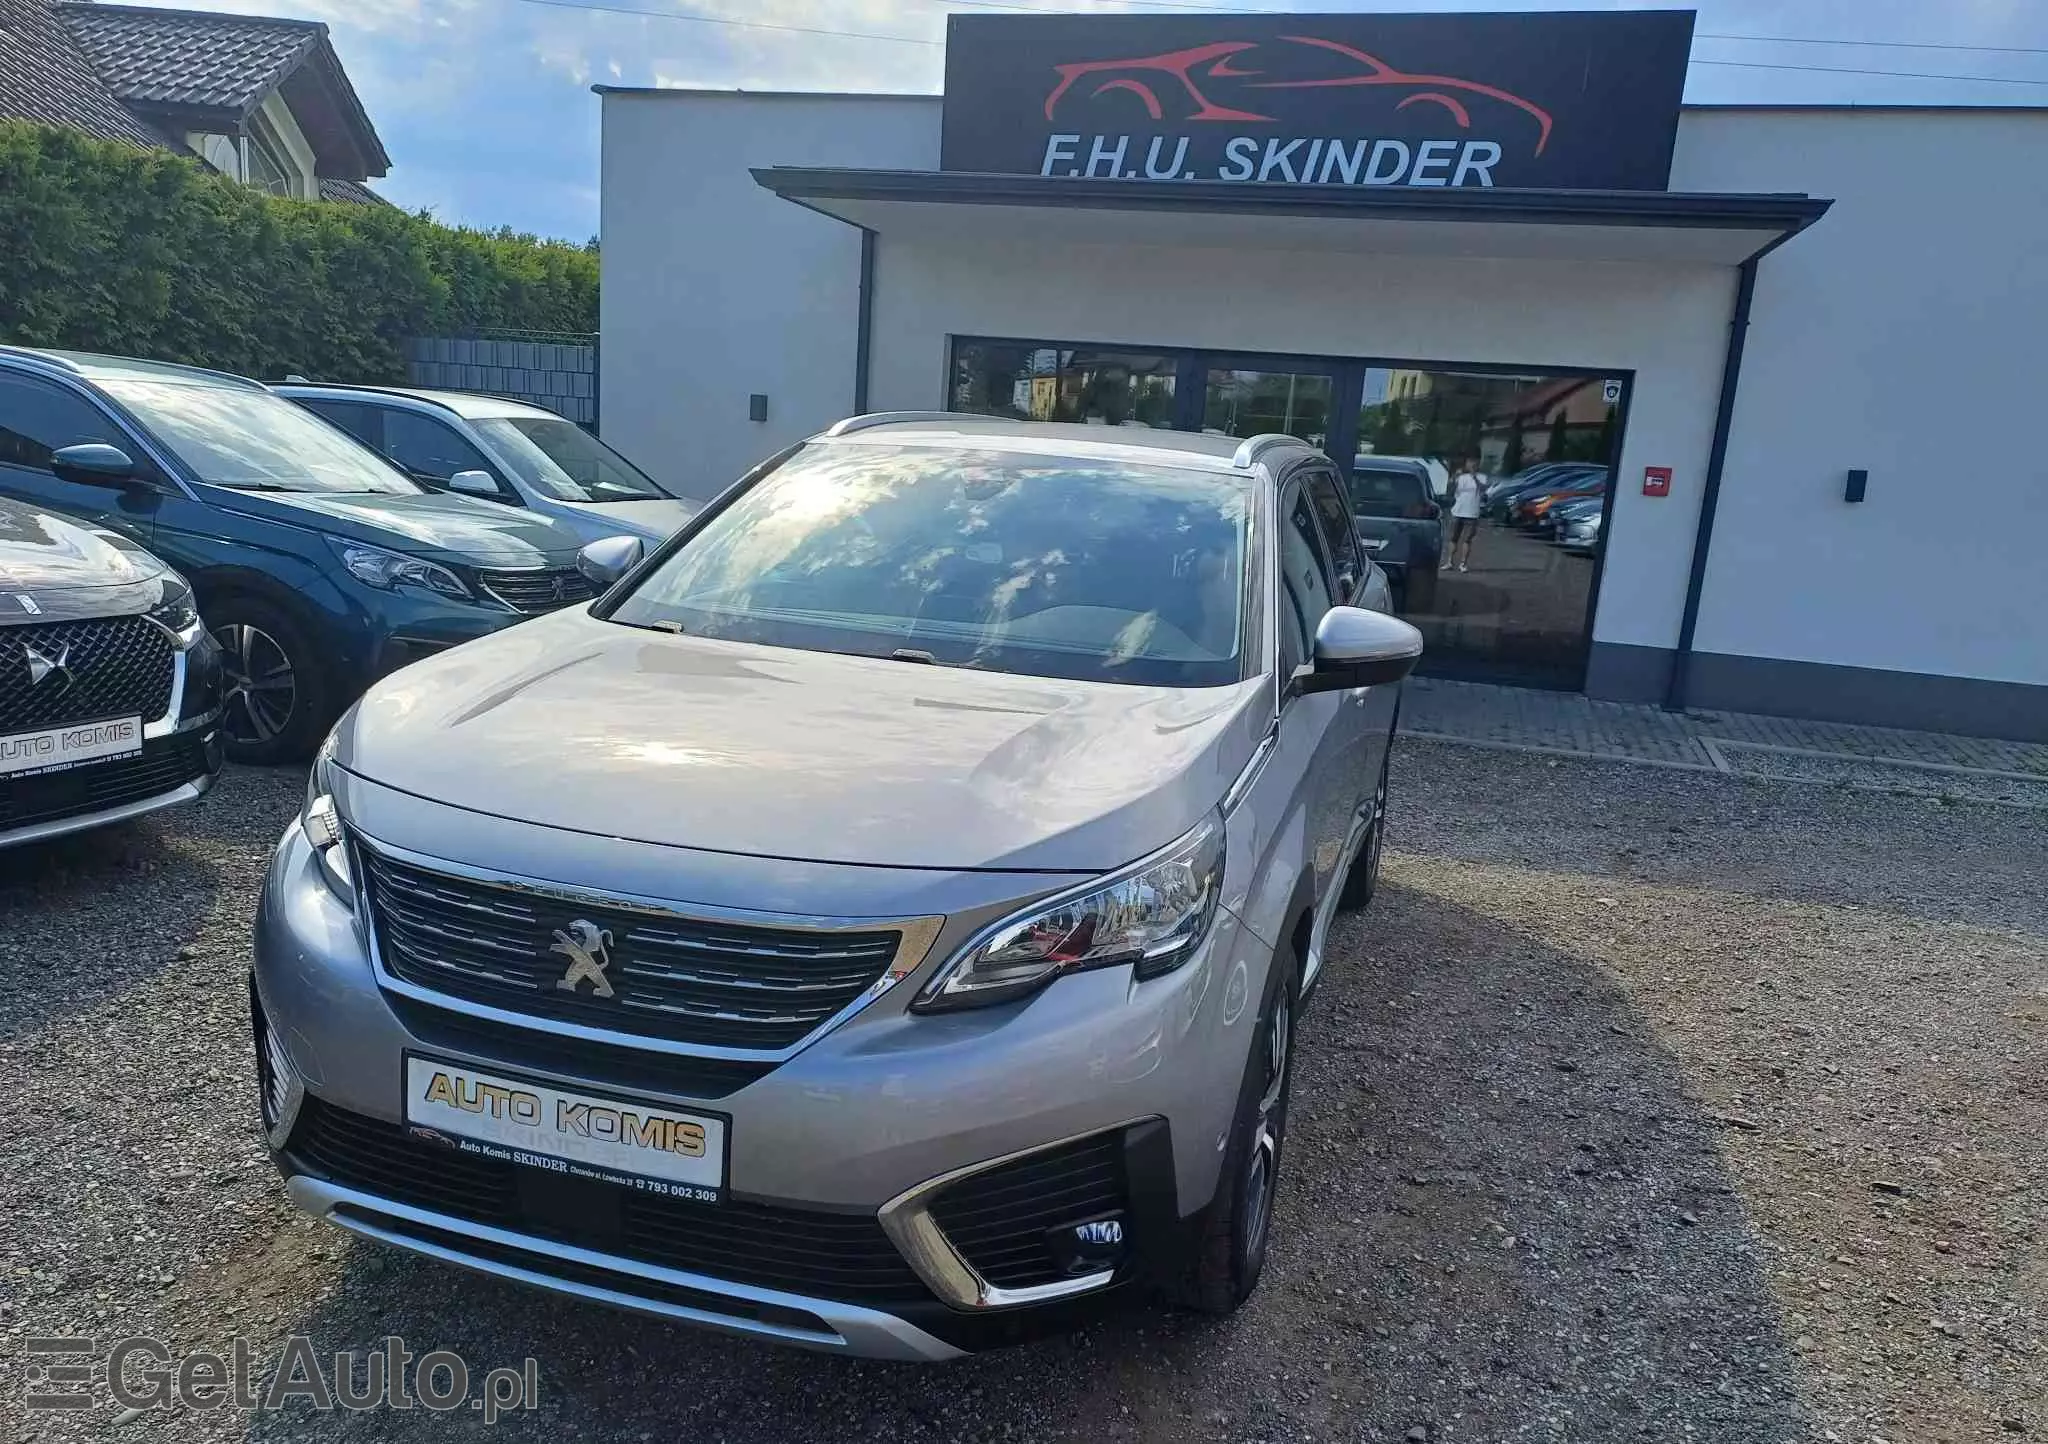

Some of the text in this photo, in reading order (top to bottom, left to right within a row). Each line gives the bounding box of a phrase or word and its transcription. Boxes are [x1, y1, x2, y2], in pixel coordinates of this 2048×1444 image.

[1041, 134, 1502, 187] F.H.U. SKINDER
[0, 721, 134, 760] UTO KOMIS
[425, 1072, 706, 1158] AUTO KOMIS
[460, 1140, 481, 1153] Auto
[483, 1145, 511, 1160] Komis
[513, 1152, 568, 1173] SKINDER
[647, 1180, 668, 1194] 793
[671, 1185, 692, 1199] 002
[695, 1189, 717, 1202] 309
